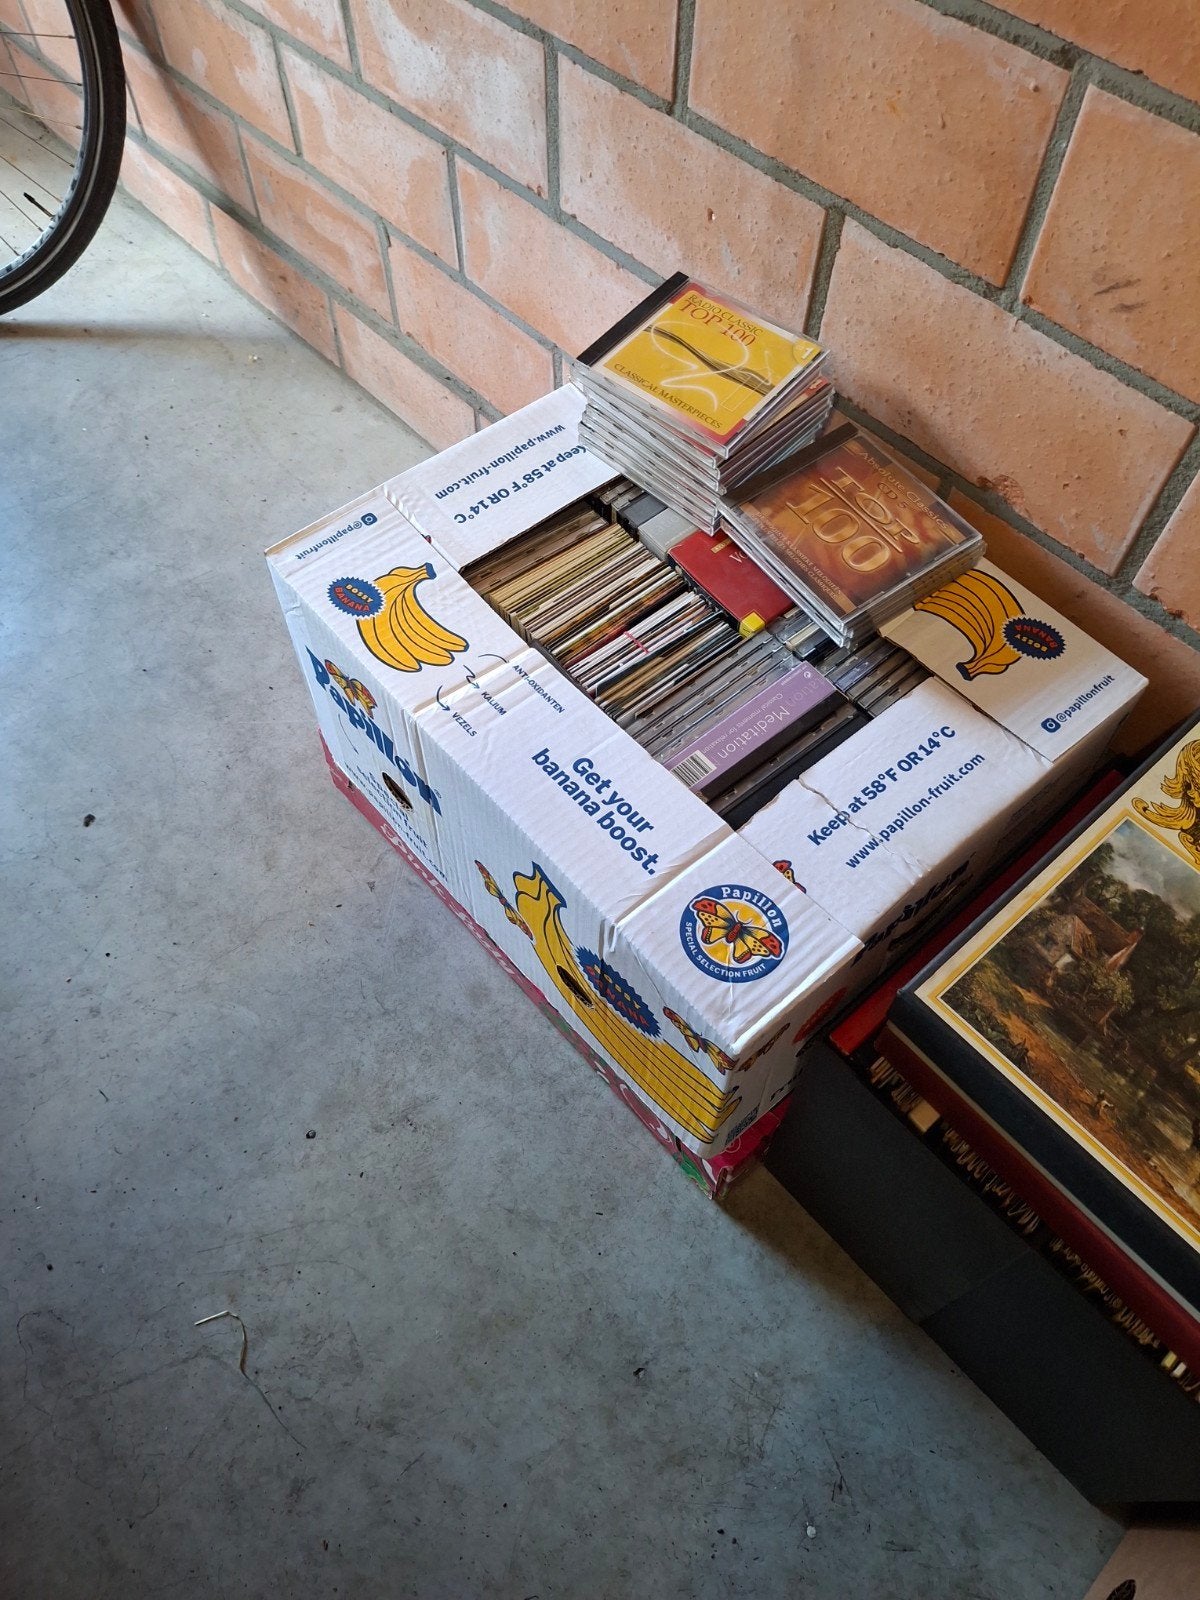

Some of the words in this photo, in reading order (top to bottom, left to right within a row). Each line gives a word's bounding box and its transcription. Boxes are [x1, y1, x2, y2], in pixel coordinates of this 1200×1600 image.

[678, 300, 723, 326] TOP
[722, 324, 756, 347] 100
[688, 293, 722, 316] RADIO
[722, 311, 764, 336] CLASSIC
[614, 363, 660, 394] CLASSICAL
[659, 388, 723, 430] MASTERPIECES
[434, 424, 565, 500] www.papillon-fruit.com
[512, 469, 544, 492] 58°F
[537, 460, 557, 475] at
[454, 499, 489, 524] 14°C
[487, 487, 511, 504] OR
[829, 466, 920, 545] TOP
[860, 452, 904, 492] Absolute
[906, 492, 948, 528] Classics
[878, 482, 898, 500] CD
[296, 519, 363, 561] @papillonfruit
[786, 483, 890, 572] 100
[334, 586, 371, 613] BANANA
[345, 583, 374, 605] BOSSY
[1014, 624, 1060, 649] BANANA
[1014, 633, 1048, 652] BOSSY
[481, 691, 507, 717] KALIUM
[514, 664, 565, 714] ANTI-OXIDANTEN
[1055, 674, 1116, 724] @papillonfruit
[306, 645, 443, 818] Papillon
[452, 712, 478, 738] VEZELS
[718, 706, 790, 759] Meditation
[736, 709, 762, 730] moments
[702, 731, 730, 754] relaxation
[572, 756, 612, 794] Get
[602, 790, 654, 834] your
[806, 810, 851, 846] Keep
[848, 796, 868, 814] at
[862, 768, 899, 802] 58°F
[896, 750, 924, 772] OR
[920, 726, 956, 757] 14°C
[531, 748, 602, 817] banana
[596, 810, 657, 875] boost.
[846, 752, 986, 870] www.papillon-fruit.com
[720, 886, 782, 928] Papillon
[685, 921, 698, 958] SPECIAL
[696, 953, 742, 978] SELECTION
[742, 963, 766, 978] FRUIT
